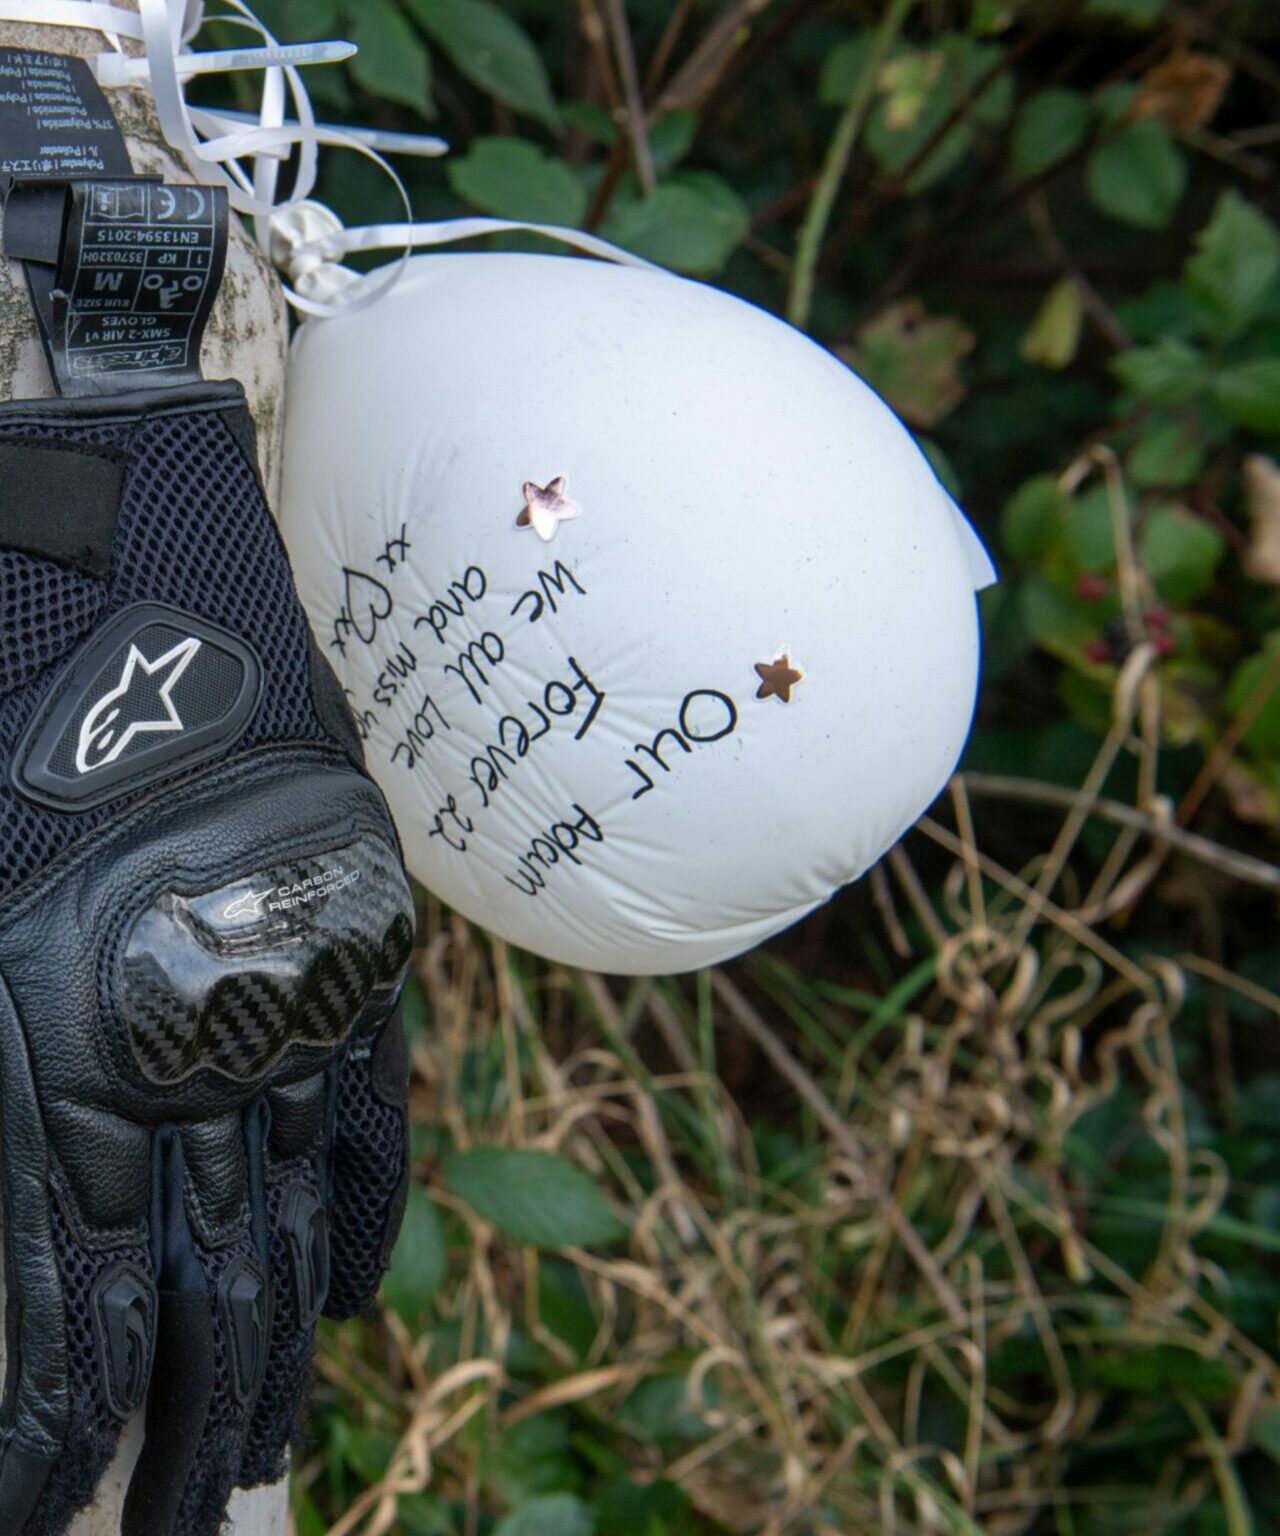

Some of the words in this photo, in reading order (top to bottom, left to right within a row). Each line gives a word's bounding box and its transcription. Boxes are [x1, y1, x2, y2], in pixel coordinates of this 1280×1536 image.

[42, 117, 92, 130] Polyamide
[92, 119, 114, 129] 37%
[61, 158, 105, 170] Polyester
[97, 230, 200, 244] EN13594:2015
[157, 254, 177, 264] KP
[197, 255, 203, 265] 1
[93, 272, 124, 291] M
[75, 299, 103, 308] SIZE
[106, 299, 130, 308] EUR
[102, 316, 157, 327] GLOVES
[85, 332, 99, 343] v1
[102, 330, 125, 342] AIR
[128, 327, 170, 341] SMX-2
[511, 560, 587, 622] We
[413, 566, 487, 644] and
[444, 632, 504, 705] all
[470, 657, 606, 807] Forever
[625, 689, 738, 800] Our
[429, 794, 474, 851] 22
[505, 804, 605, 896] Adam
[278, 866, 344, 897] CARBON
[269, 870, 360, 912] REINFORCED
